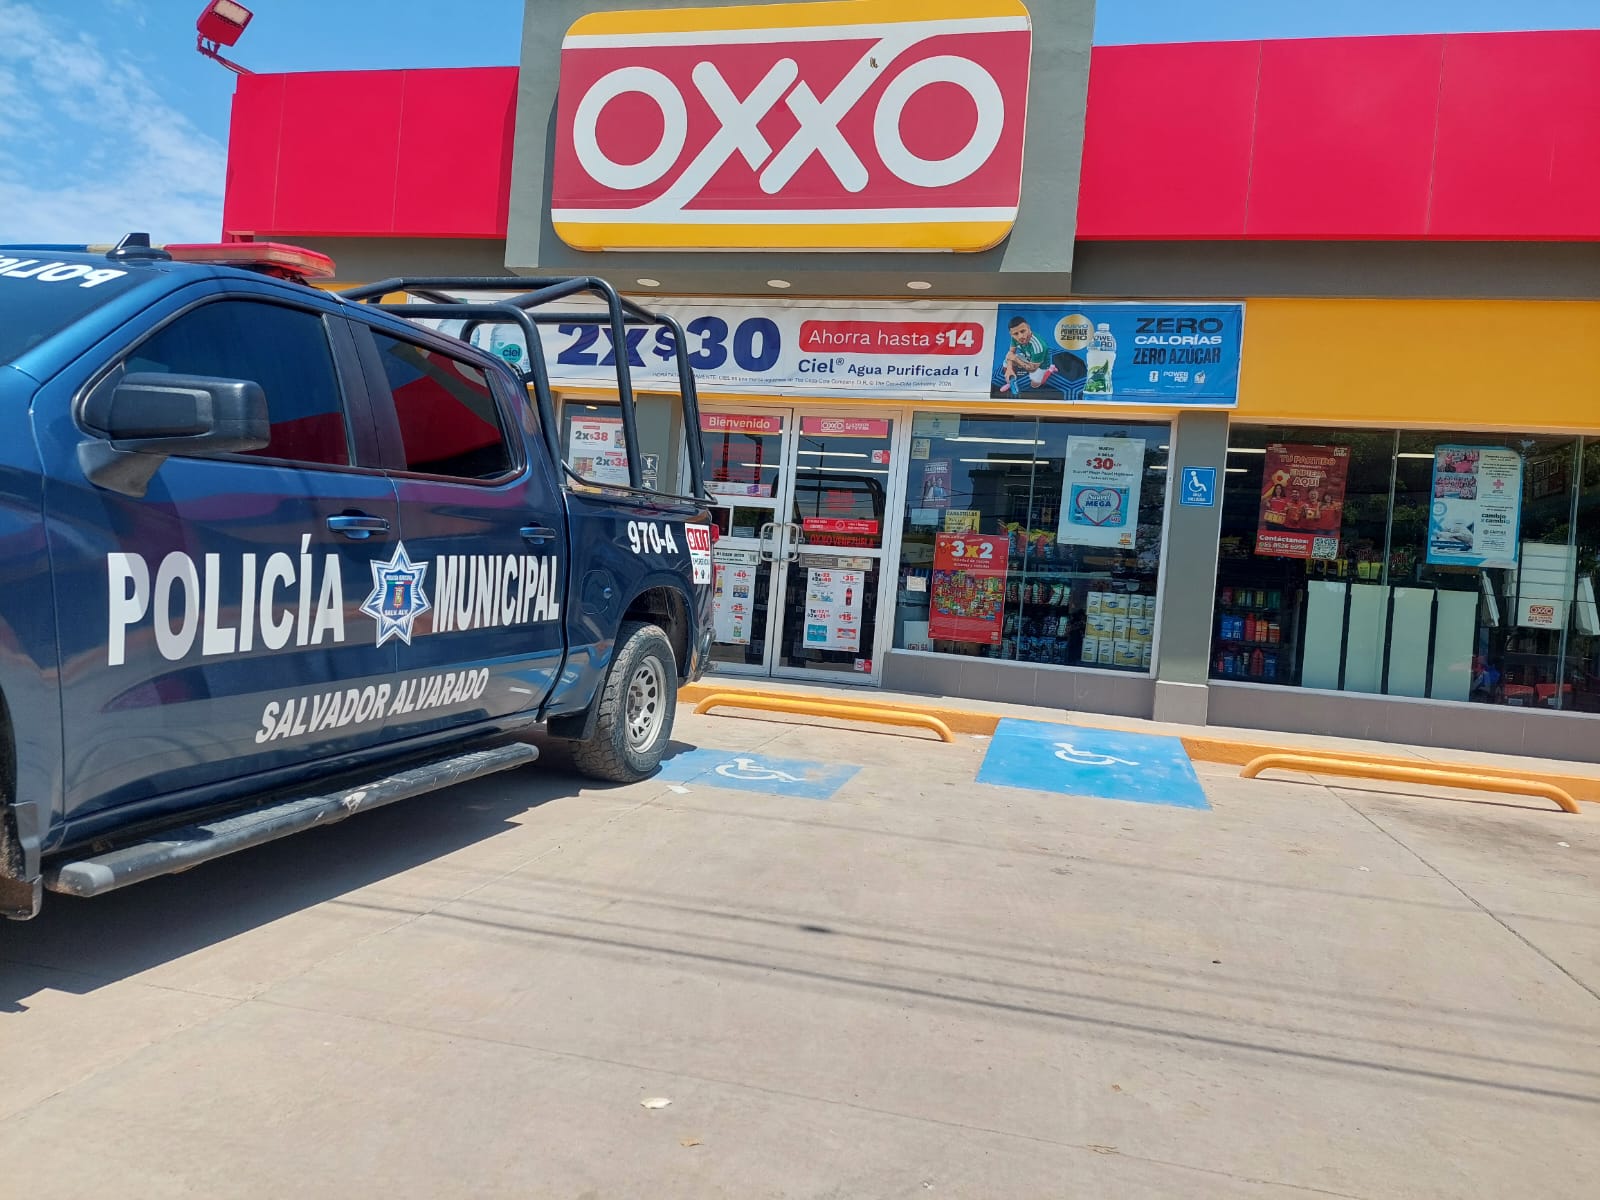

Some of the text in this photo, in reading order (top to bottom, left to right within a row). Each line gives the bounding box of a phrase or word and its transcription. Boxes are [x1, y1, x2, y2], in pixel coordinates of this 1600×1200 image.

[573, 46, 1004, 203] OXXO
[1135, 317, 1224, 334] ZERO
[808, 329, 974, 348] Ahorra hasta $14
[1134, 333, 1222, 345] CALORÍAS
[1132, 345, 1221, 365] ZERO AZÚCAR
[848, 363, 882, 378] Agua
[887, 364, 959, 377] Purificada
[963, 366, 970, 376] 1
[709, 416, 771, 429] Bienvenido
[822, 421, 843, 431] OXXO
[627, 520, 679, 554] 970-A
[950, 540, 994, 559] 3x2
[107, 533, 560, 666] POLICÍA MUNICIPAL
[1531, 606, 1552, 615] OXXO
[255, 667, 490, 744] SALVADOR ALVARADO
